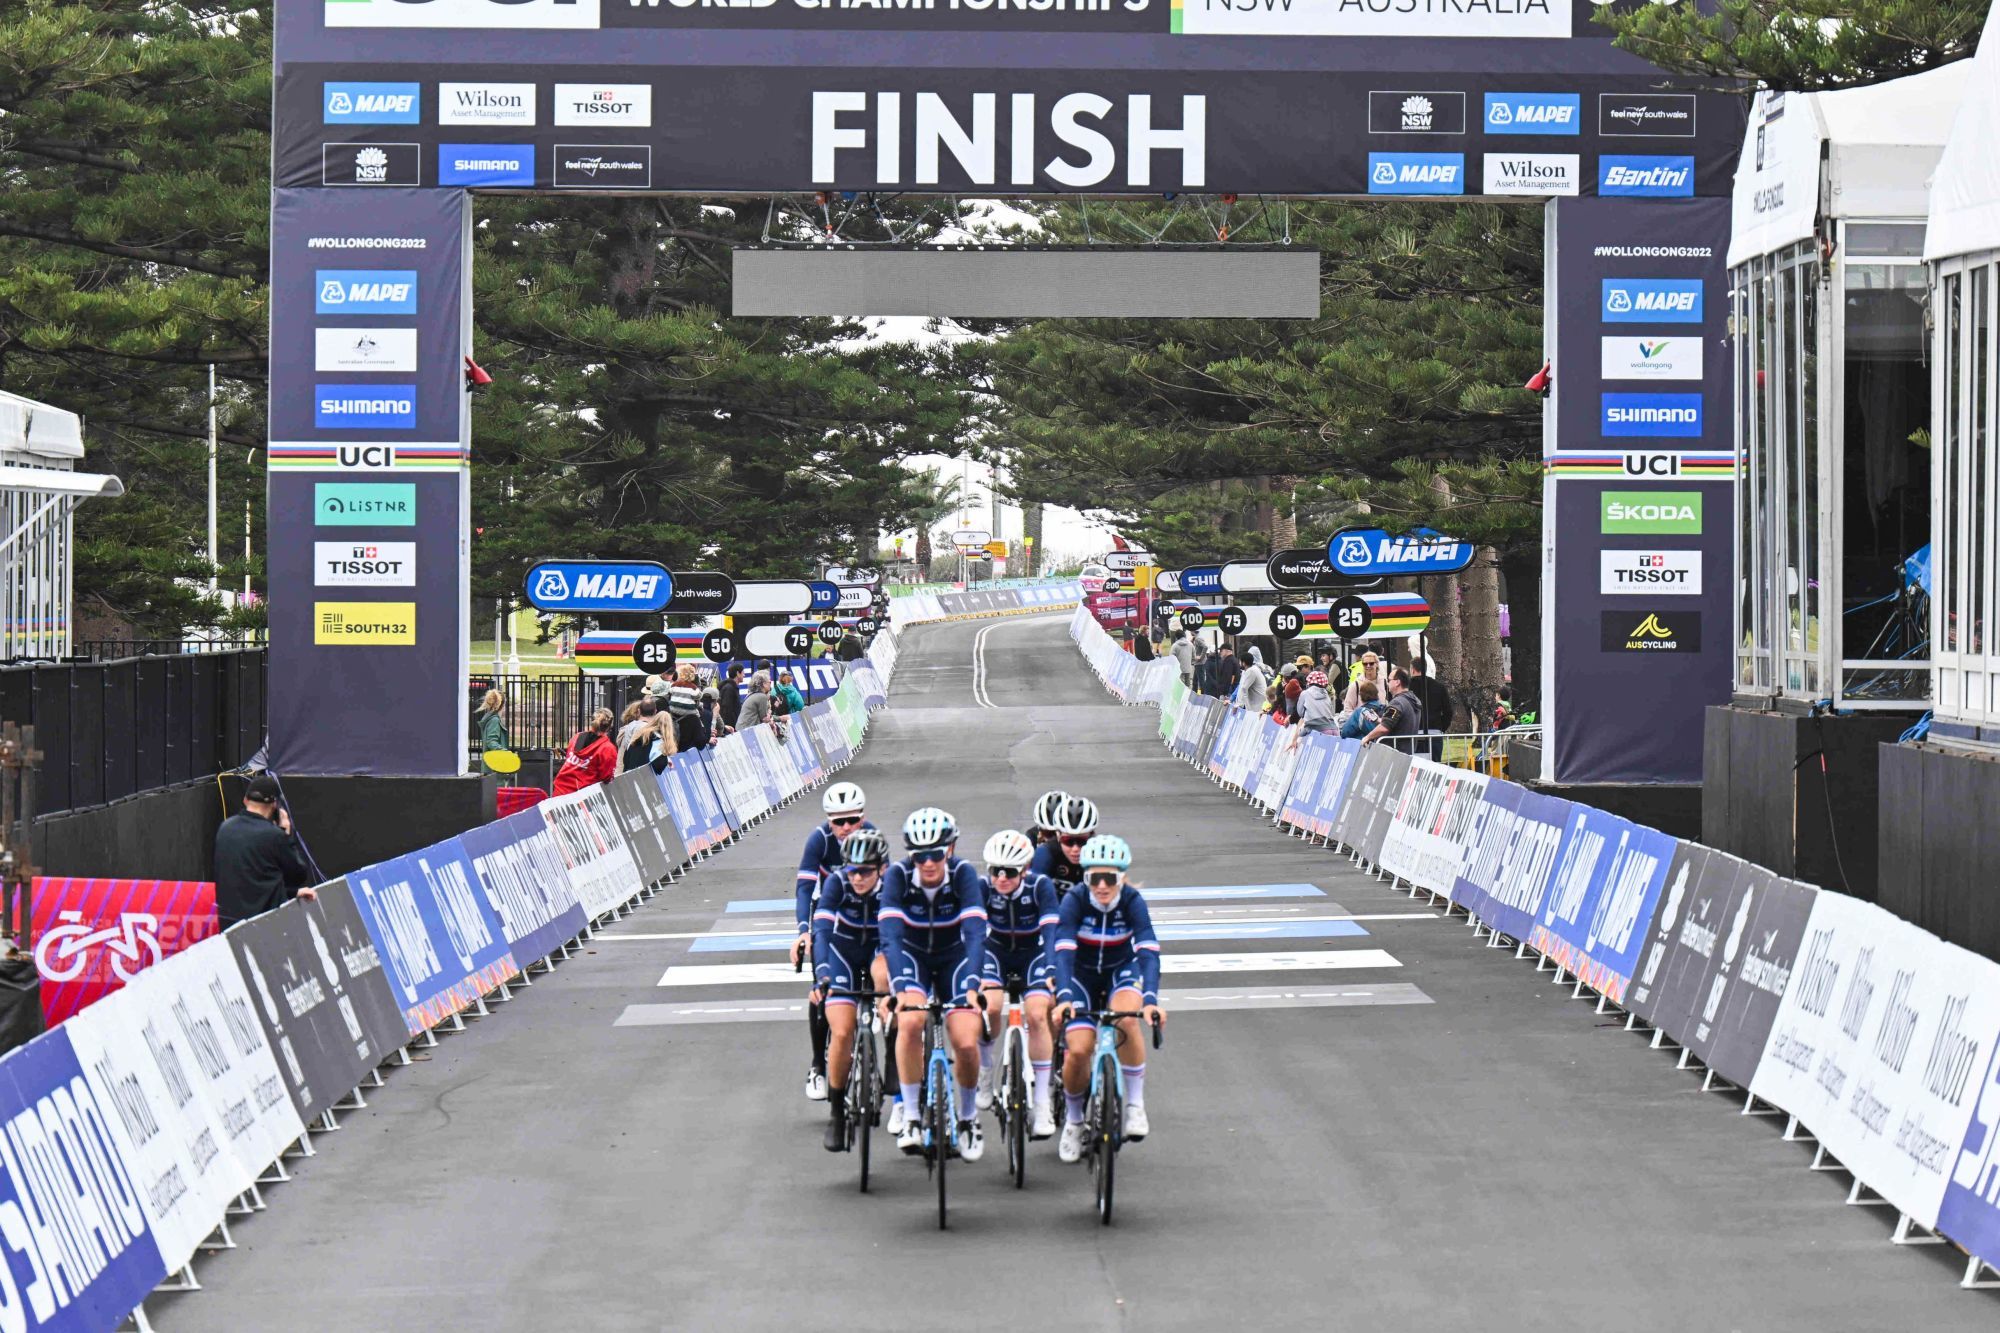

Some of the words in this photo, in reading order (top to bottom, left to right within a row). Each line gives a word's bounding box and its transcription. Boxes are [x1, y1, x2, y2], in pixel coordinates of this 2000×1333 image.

[355, 95, 414, 112] MAPEI
[456, 90, 521, 106] Wilson
[451, 109, 472, 117] Asset
[473, 109, 526, 119] Management
[573, 103, 632, 113] TISSOT
[1516, 105, 1572, 122] MAPEI
[1611, 110, 1626, 118] feel
[1645, 110, 1665, 118] south
[1666, 110, 1687, 119] wales
[1402, 115, 1432, 125] NSW
[812, 92, 1206, 187] FINISH
[356, 167, 387, 178] NSW
[455, 160, 519, 171] SHIMANO
[565, 161, 581, 169] feel
[599, 161, 620, 169] south
[621, 161, 643, 170] wales
[1500, 161, 1565, 177] Wilson
[1400, 166, 1457, 182] MAPEI
[1604, 167, 1688, 186] Santini
[1495, 179, 1516, 188] Asset
[1518, 180, 1570, 189] Management
[308, 238, 426, 248] #WOLLONGONG2022
[1594, 247, 1712, 257] #WOLLONGONG2022
[349, 284, 410, 301] MAPEI
[1635, 292, 1695, 310] MAPEI
[1630, 362, 1672, 370] wollongong
[321, 400, 411, 414] SHIMANO
[1607, 408, 1696, 422] SHIMANO
[340, 447, 391, 467] UCI
[1626, 455, 1677, 475] UCI
[1607, 503, 1696, 520] ŠKODA
[1377, 538, 1459, 563] MAPEI
[328, 561, 402, 574] TISSOT
[1281, 564, 1299, 573] feel
[1614, 569, 1688, 583] TISSOT
[574, 574, 659, 599] MAPEI
[695, 588, 722, 598] wales
[1159, 606, 1174, 614] 150
[1339, 608, 1363, 626] 25
[1182, 613, 1202, 624] 100
[1225, 615, 1241, 627] 75
[1277, 615, 1297, 630] 50
[820, 627, 841, 638] 100
[858, 622, 875, 631] 150
[711, 638, 731, 654] 50
[791, 634, 808, 647] 75
[1626, 641, 1677, 649] AUSCYCLING
[643, 644, 667, 663] 25
[469, 839, 552, 946] SHIMANO
